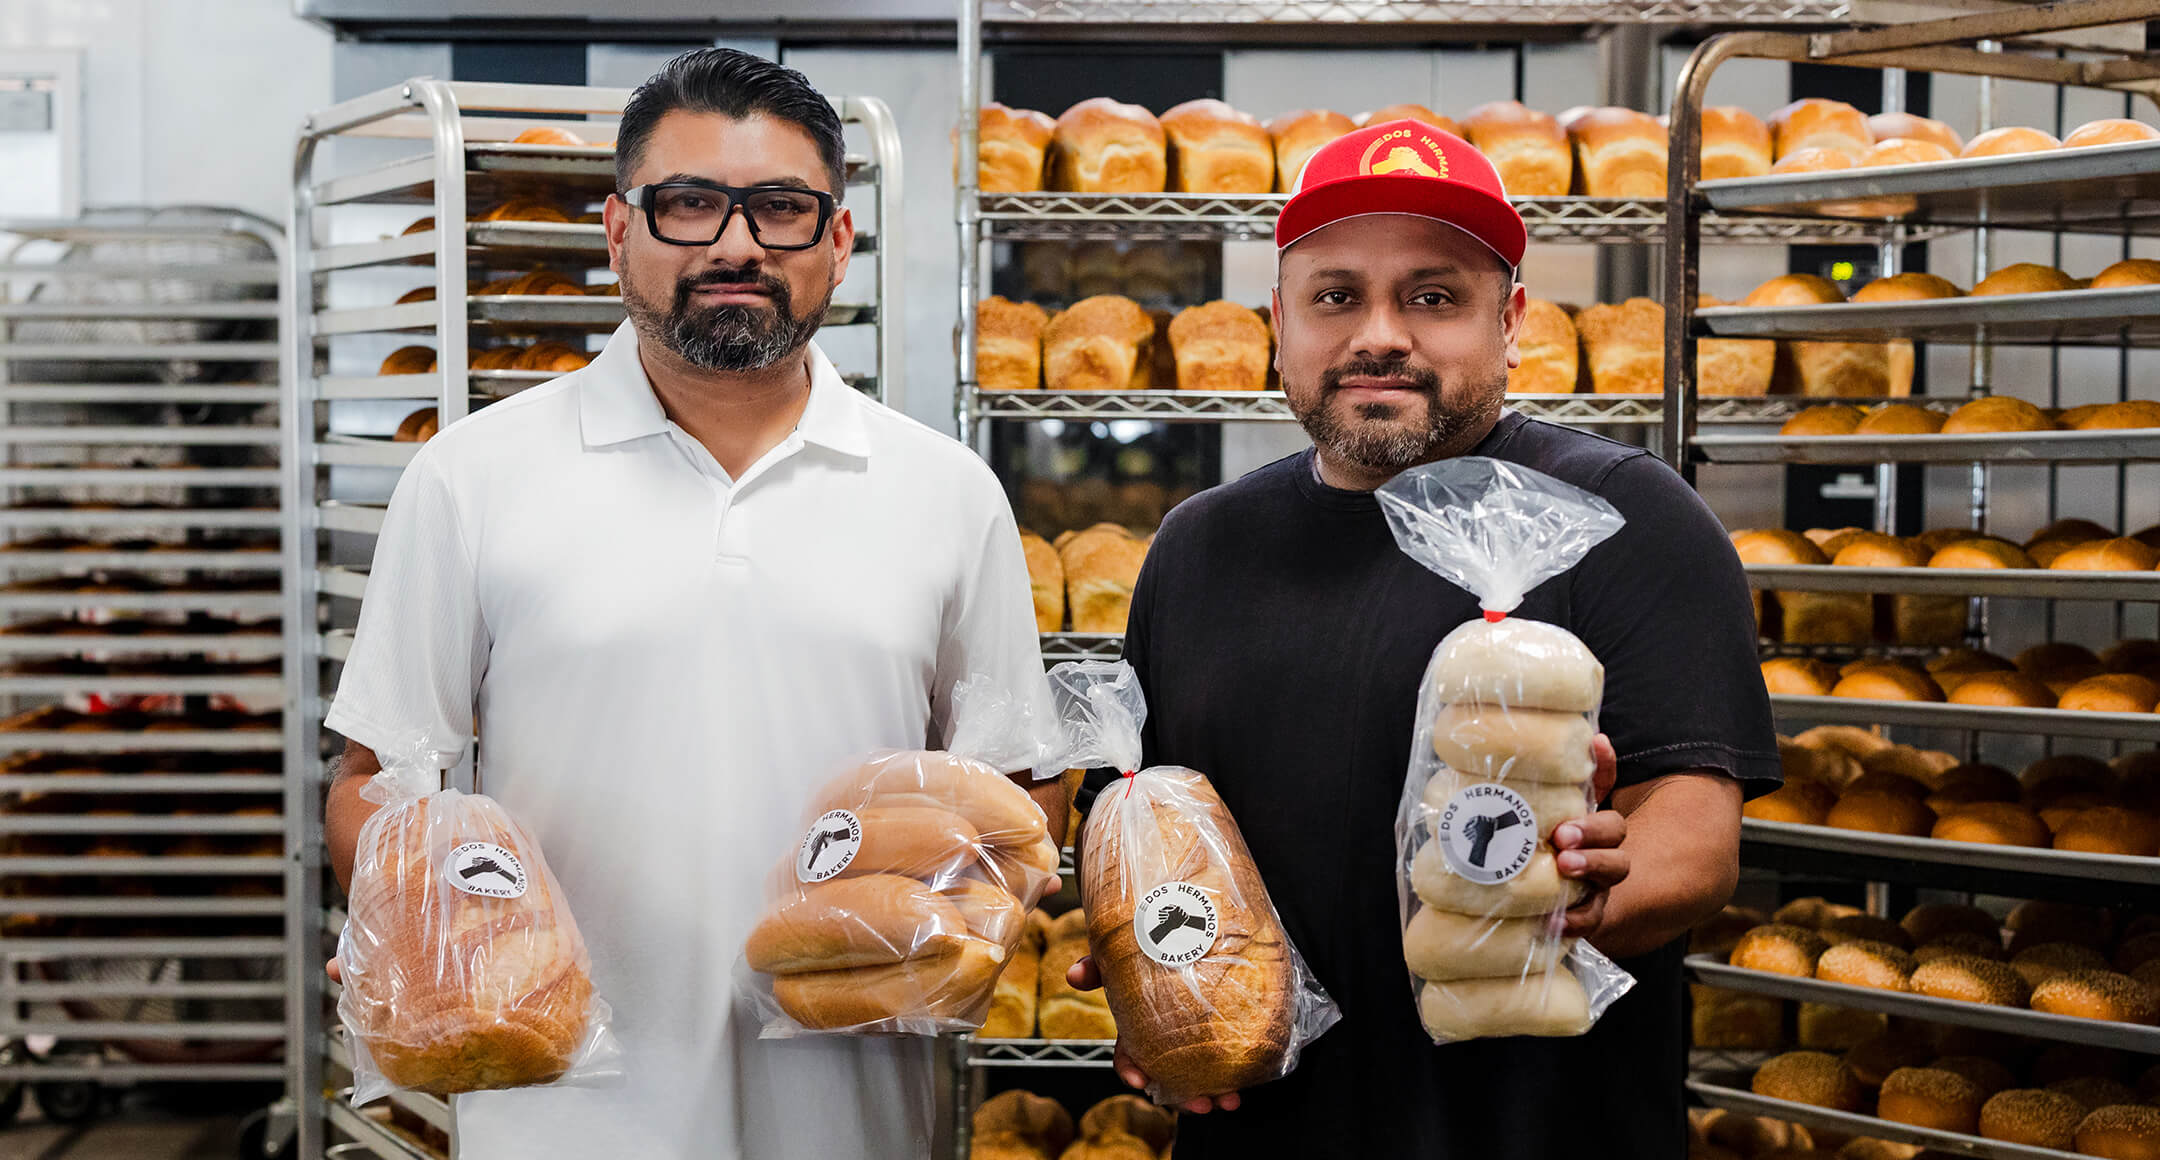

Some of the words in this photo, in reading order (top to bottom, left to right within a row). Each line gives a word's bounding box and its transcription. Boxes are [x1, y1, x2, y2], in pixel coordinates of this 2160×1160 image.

[1382, 129, 1411, 141] DOS
[1441, 803, 1459, 830] DOS
[1464, 787, 1534, 827] HERMANOS
[822, 811, 860, 842] HERMANOS
[461, 843, 486, 853] DOS
[1495, 838, 1534, 880] BAKERY
[816, 850, 853, 880] BAKERY
[1145, 886, 1169, 904] DOS
[1177, 884, 1216, 938] HERMANOS
[1160, 944, 1205, 963] BAKERY
